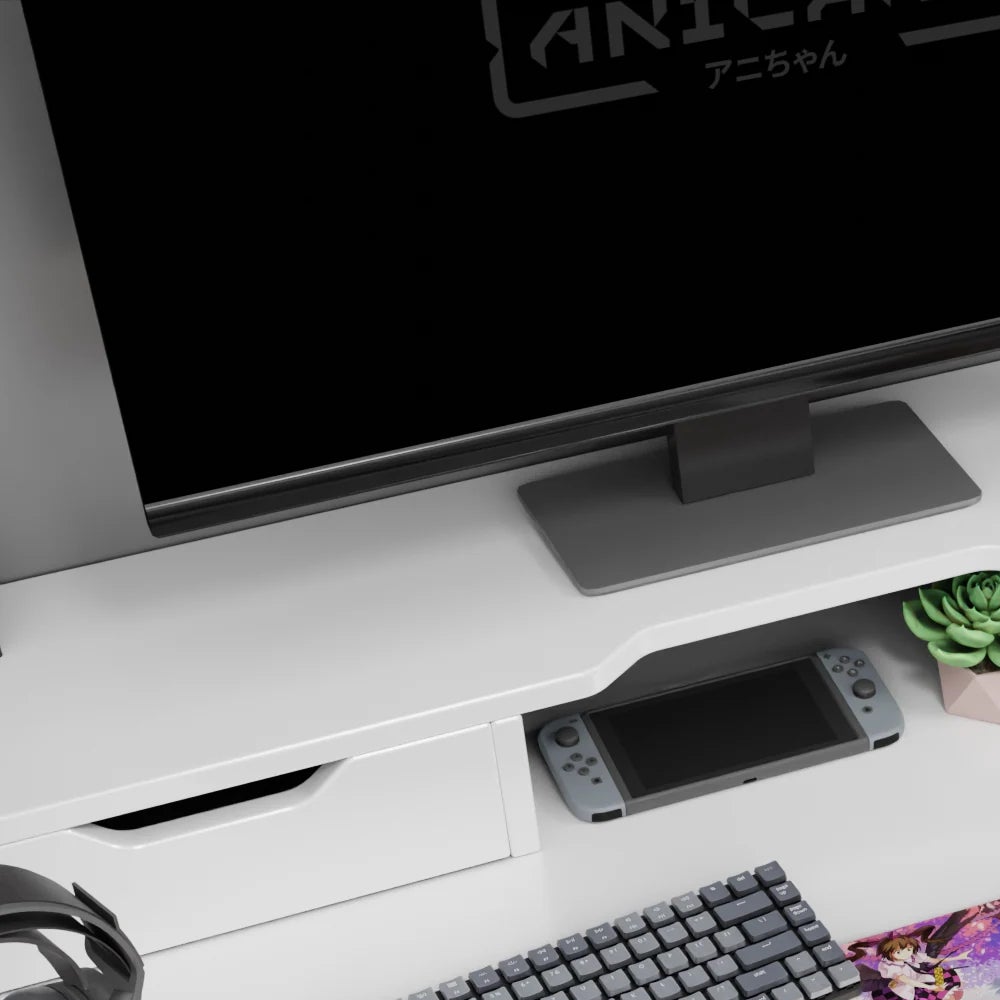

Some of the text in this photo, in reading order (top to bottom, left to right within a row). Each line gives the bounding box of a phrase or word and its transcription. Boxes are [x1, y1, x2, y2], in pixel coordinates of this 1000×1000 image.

[705, 40, 847, 90] アニちゃん
